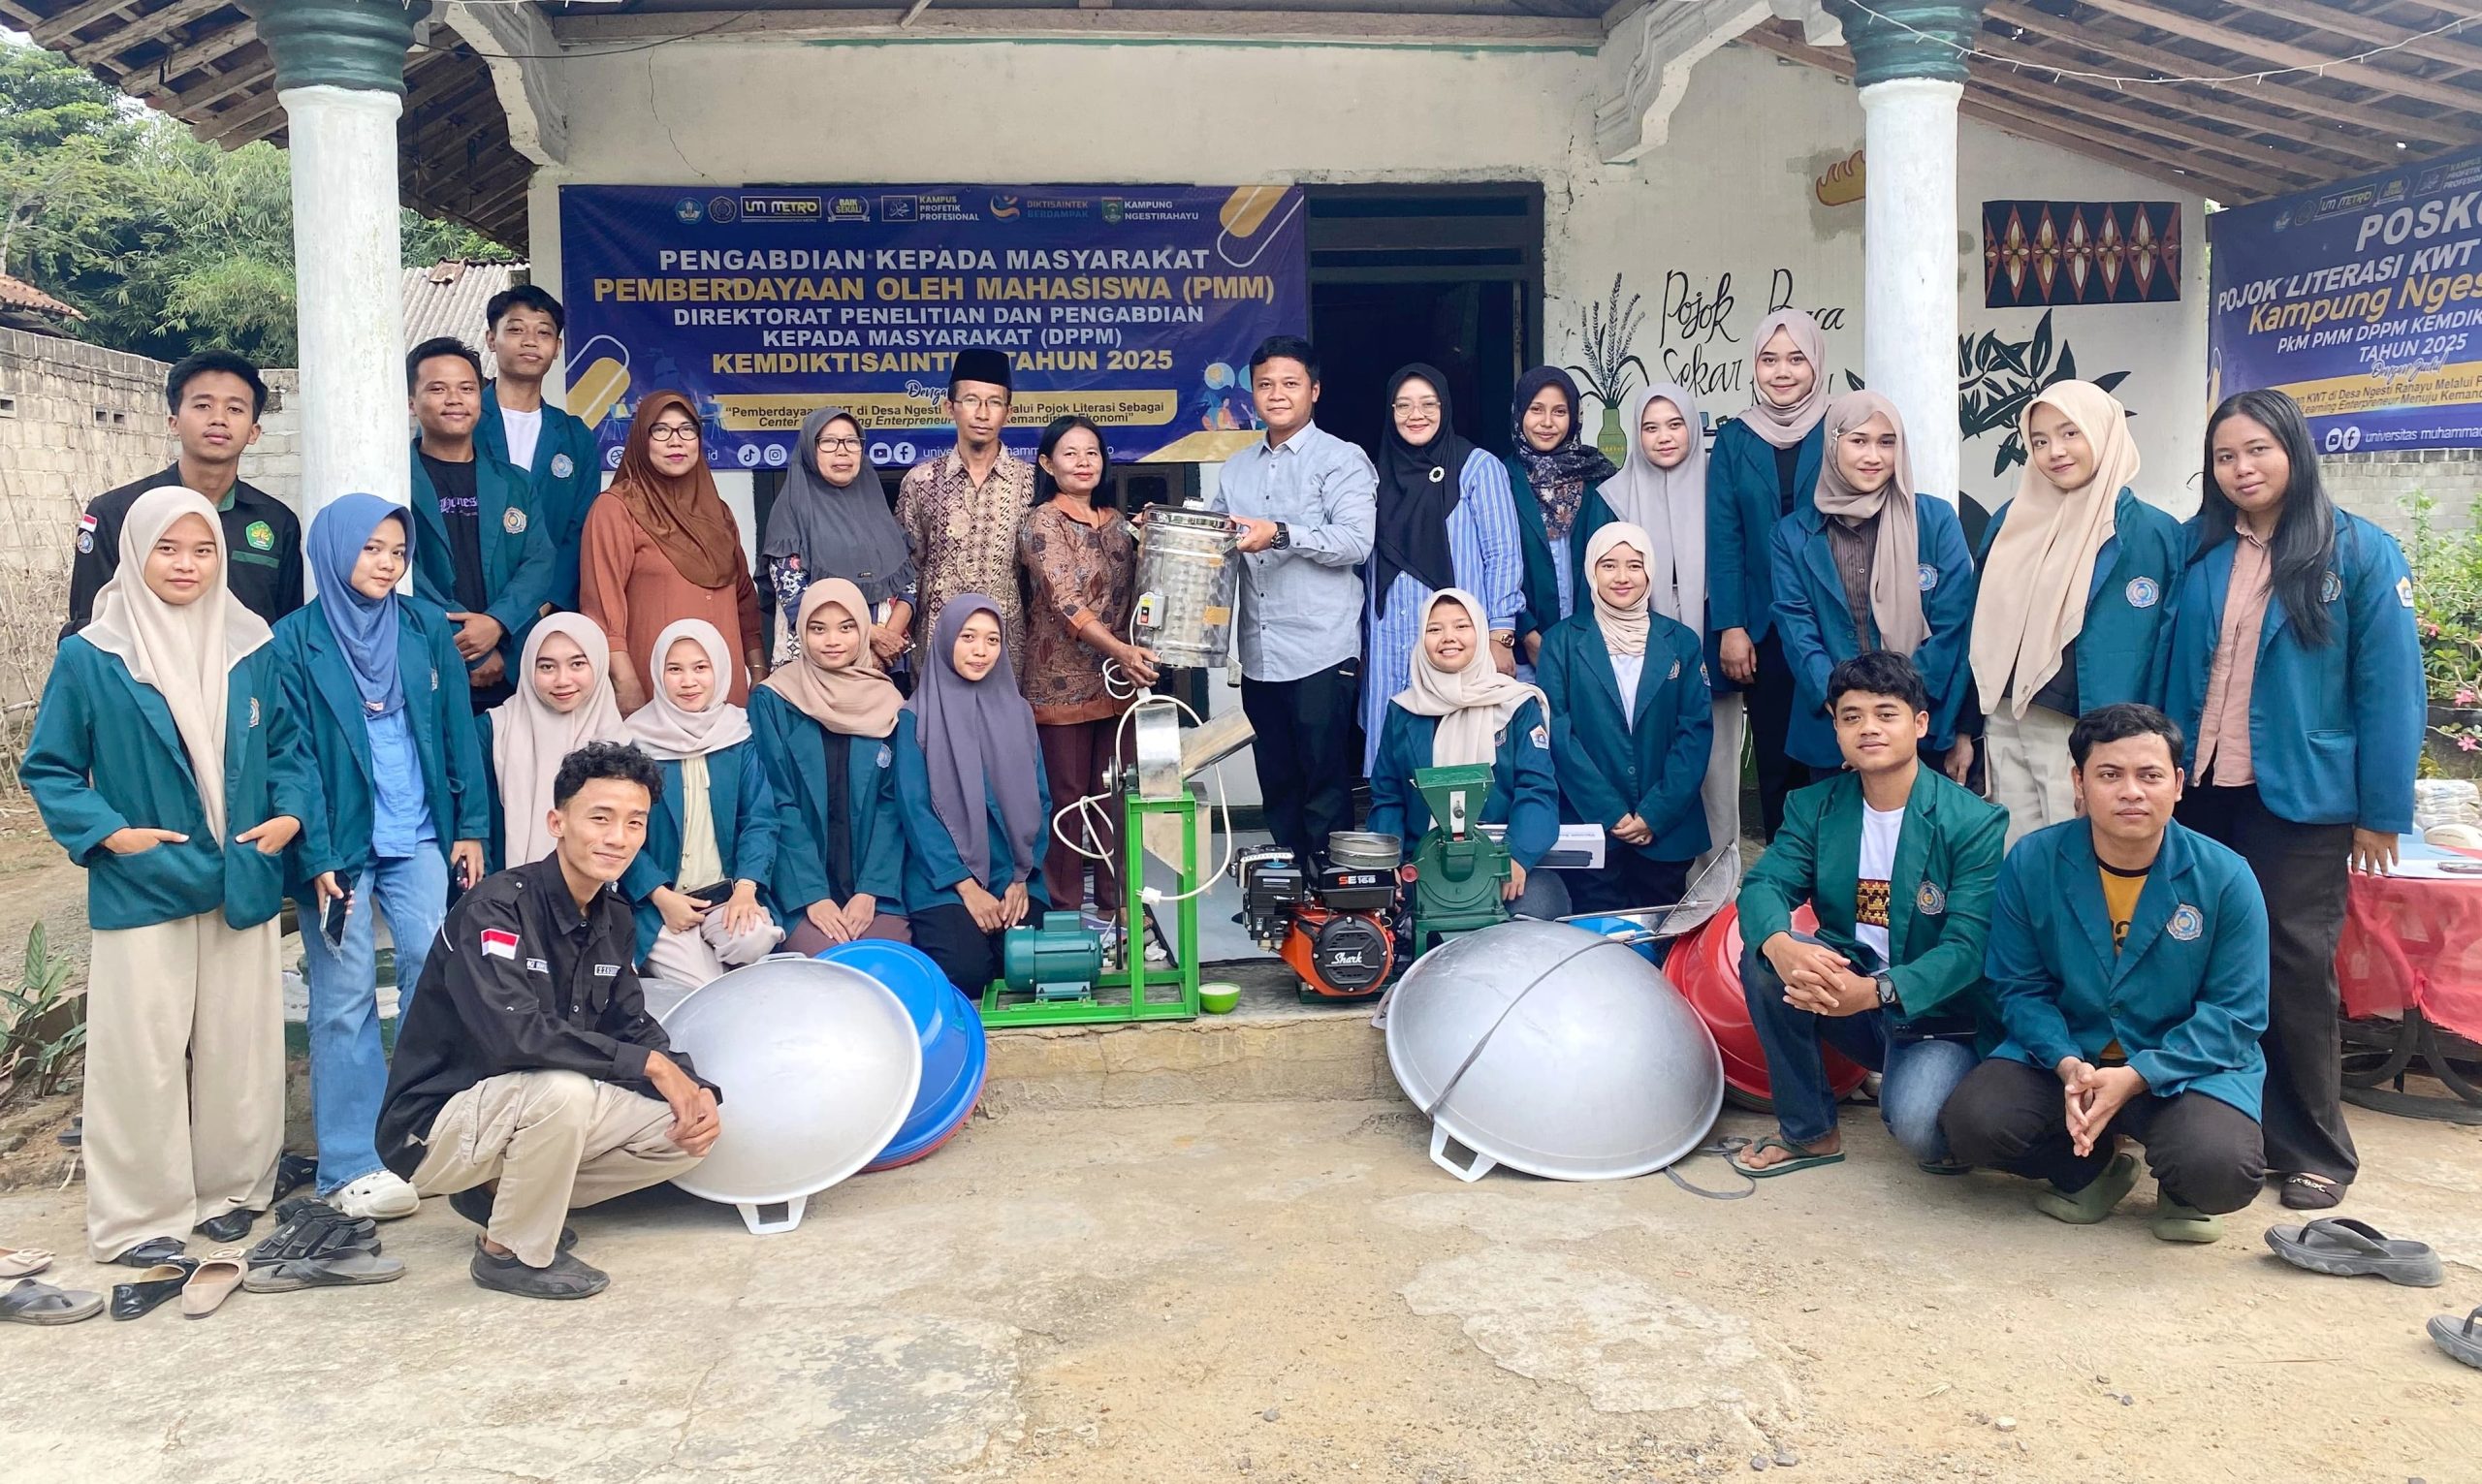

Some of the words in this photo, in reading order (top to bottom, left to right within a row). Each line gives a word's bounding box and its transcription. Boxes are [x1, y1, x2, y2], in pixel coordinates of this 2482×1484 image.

[771, 201, 817, 213] METRO
[1027, 200, 1089, 208] DIKTISAINTEK
[920, 212, 979, 221] PROFESIONAL
[1124, 212, 1198, 221] NGESTIRAHAYU
[2355, 191, 2482, 252] POSK
[660, 249, 865, 270] PENGABDIAN
[876, 249, 997, 270] KEPADA
[1006, 249, 1210, 270] MASYARAKAT
[2218, 277, 2286, 315] POJOK
[2285, 253, 2404, 298] LITERASI
[2408, 238, 2481, 276] KWT
[594, 277, 865, 301] PEMBERDAYAAN
[876, 277, 964, 301] OLEH
[976, 276, 1173, 300] MAHASISWA
[1183, 275, 1275, 305] (PMM)
[674, 308, 832, 326] DIREKTORAT
[841, 307, 986, 325] PENELITIAN
[994, 307, 1042, 324] DAN
[1050, 306, 1204, 323] PENGABDIAN
[1660, 269, 1740, 348] Pojok
[1767, 268, 1846, 331] Bca
[2248, 286, 2393, 335] Kampung
[763, 330, 861, 347] KEPADA
[869, 329, 1033, 346] MASYARAKAT
[1040, 328, 1123, 349] (DPPM)
[2277, 334, 2309, 354] PkM
[2311, 328, 2353, 348] PMM
[2355, 322, 2408, 342] DPPM
[2359, 341, 2419, 363] TAHUN
[2422, 333, 2468, 355] 2025
[713, 352, 960, 374] KEMDIKTISAINT
[1107, 350, 1173, 370] 2025
[905, 380, 948, 405] Denga
[2307, 392, 2327, 403] KWT
[2328, 390, 2338, 401] di
[2339, 389, 2361, 399] Desa
[2363, 384, 2393, 398] Ngesti
[2395, 381, 2433, 395] Rahayu
[2435, 376, 2474, 391] Melalui
[2401, 393, 2438, 405] Menuju
[725, 405, 819, 418] “Pemberdayaa
[857, 405, 868, 415] di
[872, 405, 901, 416] Desa
[905, 404, 941, 418] Ngesti
[1036, 402, 1069, 415] Pojok
[1073, 402, 1115, 413] Literasi
[1118, 402, 1164, 416] Sebagai
[759, 417, 799, 427] Center
[875, 415, 954, 428] Enterpreneur
[2366, 428, 2418, 443] universitas
[1331, 951, 1362, 964] Shark
